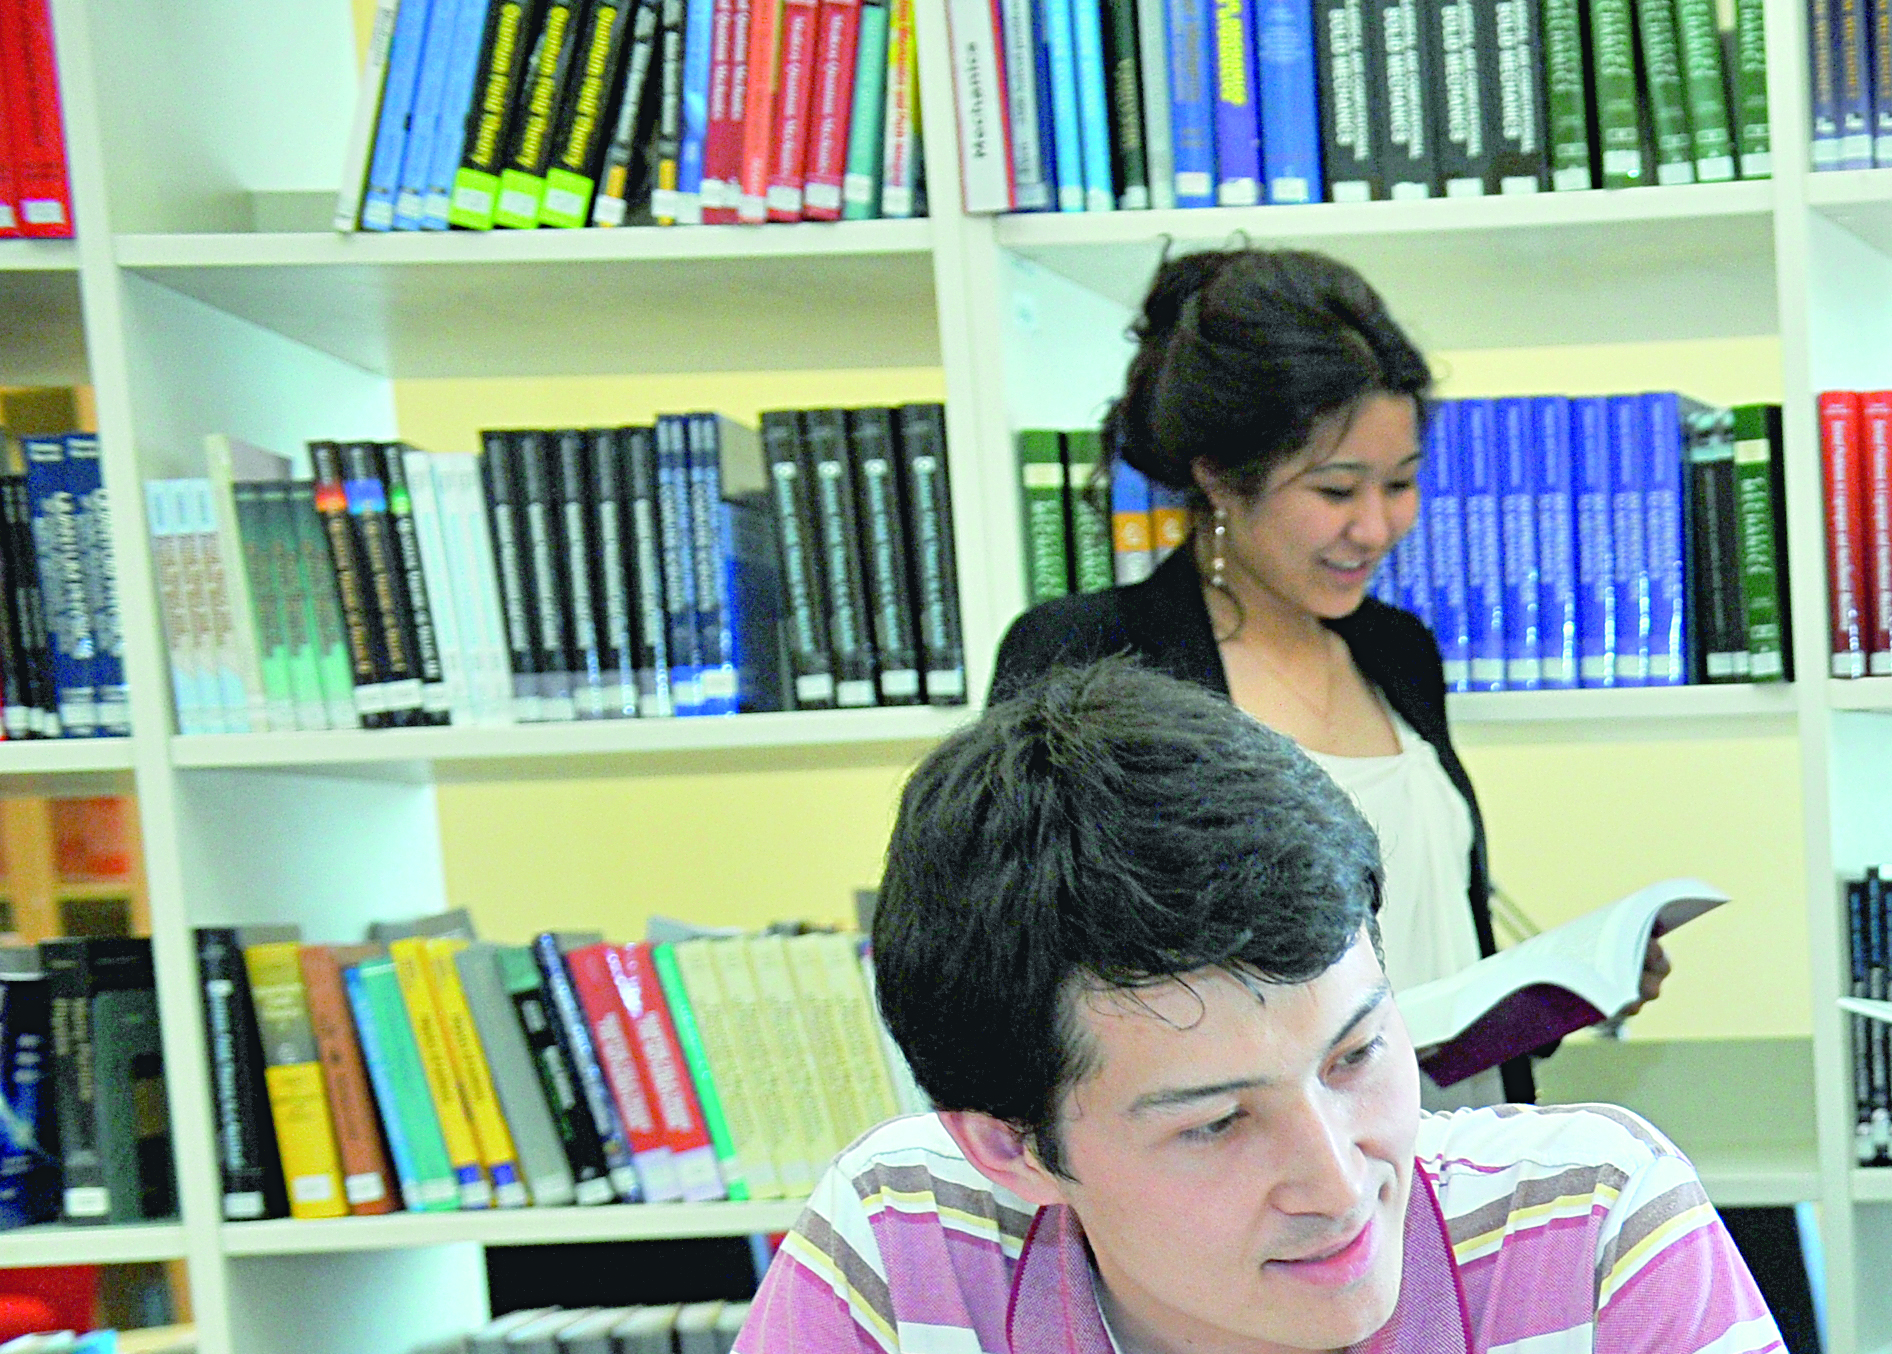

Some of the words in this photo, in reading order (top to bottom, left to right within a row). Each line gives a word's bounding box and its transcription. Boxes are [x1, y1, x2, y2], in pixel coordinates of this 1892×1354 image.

[1328, 8, 1350, 54] SOLID
[1383, 7, 1404, 53] SOLID
[1441, 5, 1462, 52] SOLID
[1496, 2, 1517, 48] SOLID
[965, 42, 987, 159] Mechanics
[1331, 56, 1354, 146] MECHANICS
[1386, 55, 1409, 144] MECHANICS
[1444, 53, 1467, 143] MECHANICS
[1498, 50, 1521, 139] MECHANICS
[1030, 499, 1066, 596] MECHANICS
[1740, 477, 1775, 576] MECHANICS
